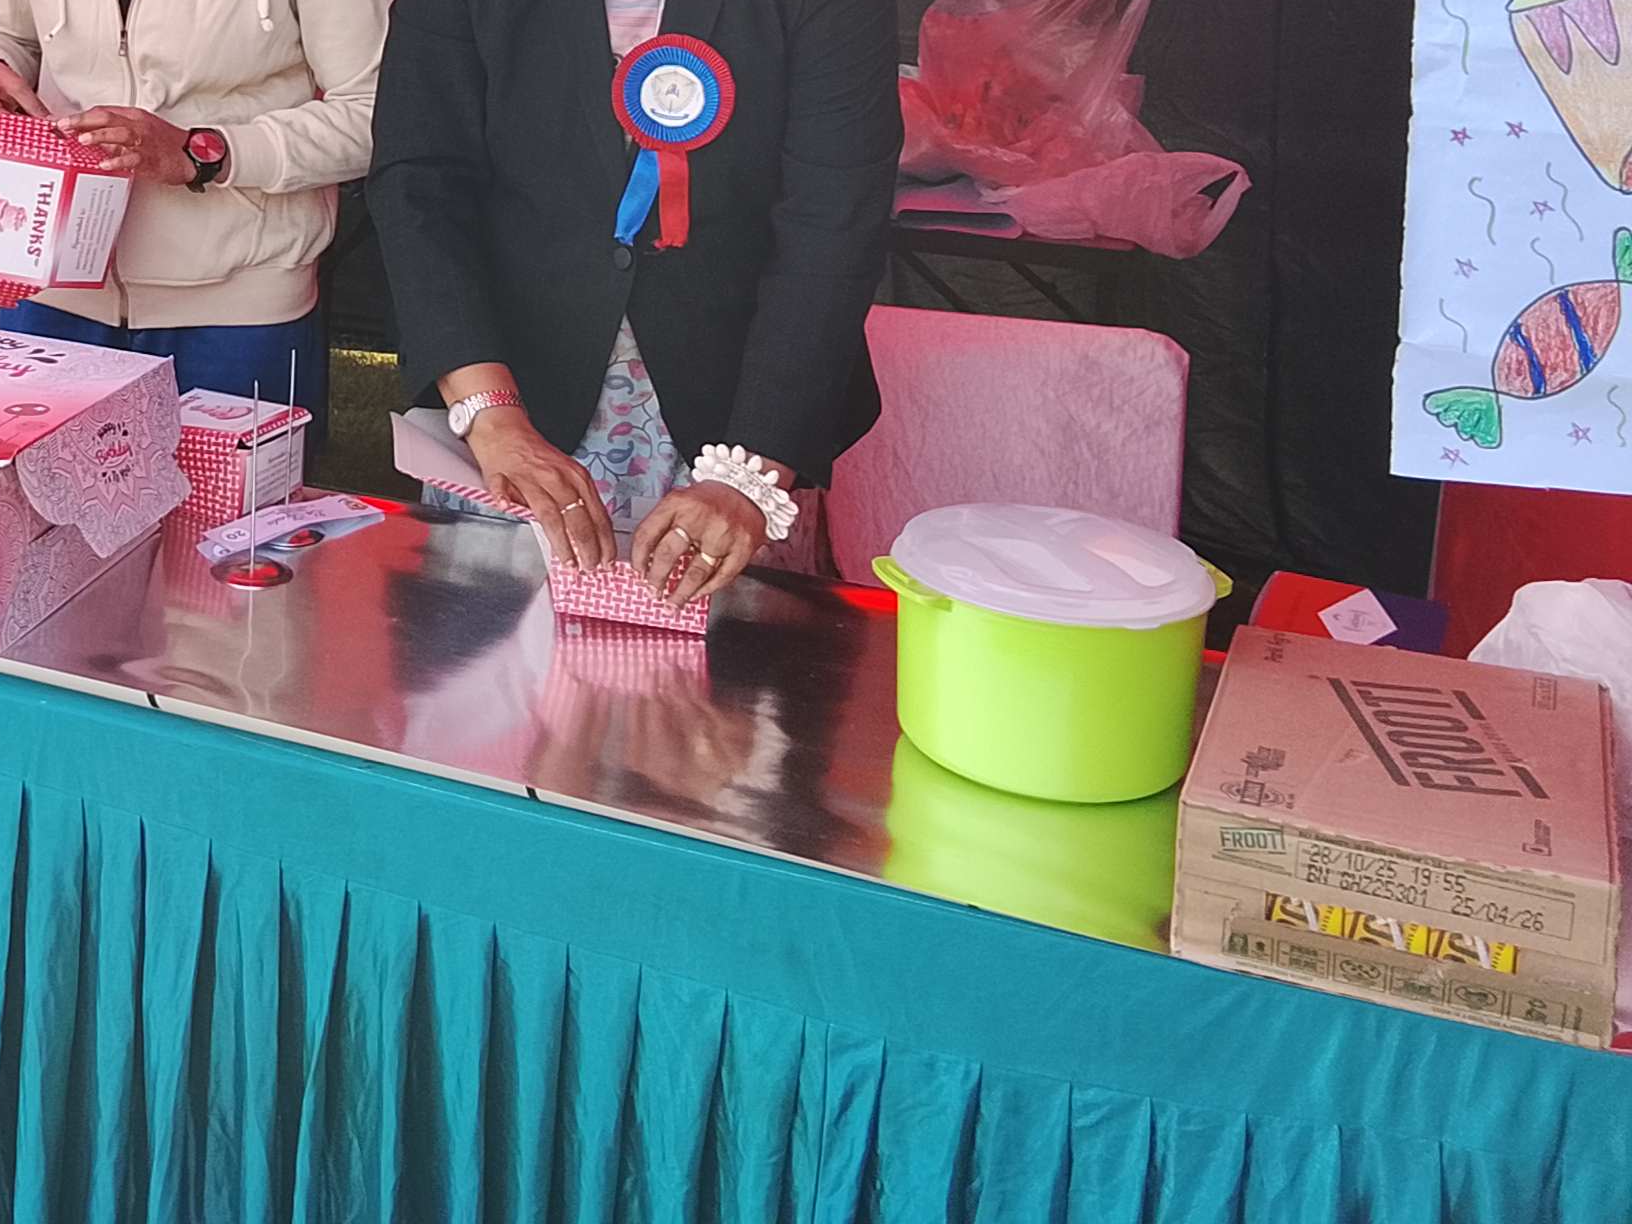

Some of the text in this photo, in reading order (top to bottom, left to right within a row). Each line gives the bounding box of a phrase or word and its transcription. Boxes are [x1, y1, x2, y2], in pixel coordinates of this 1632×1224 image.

[27, 181, 55, 258] THANKS
[1350, 680, 1523, 797] FROOTI
[1308, 844, 1397, 877] 28/10/25
[1451, 894, 1545, 932] 25/04/26
